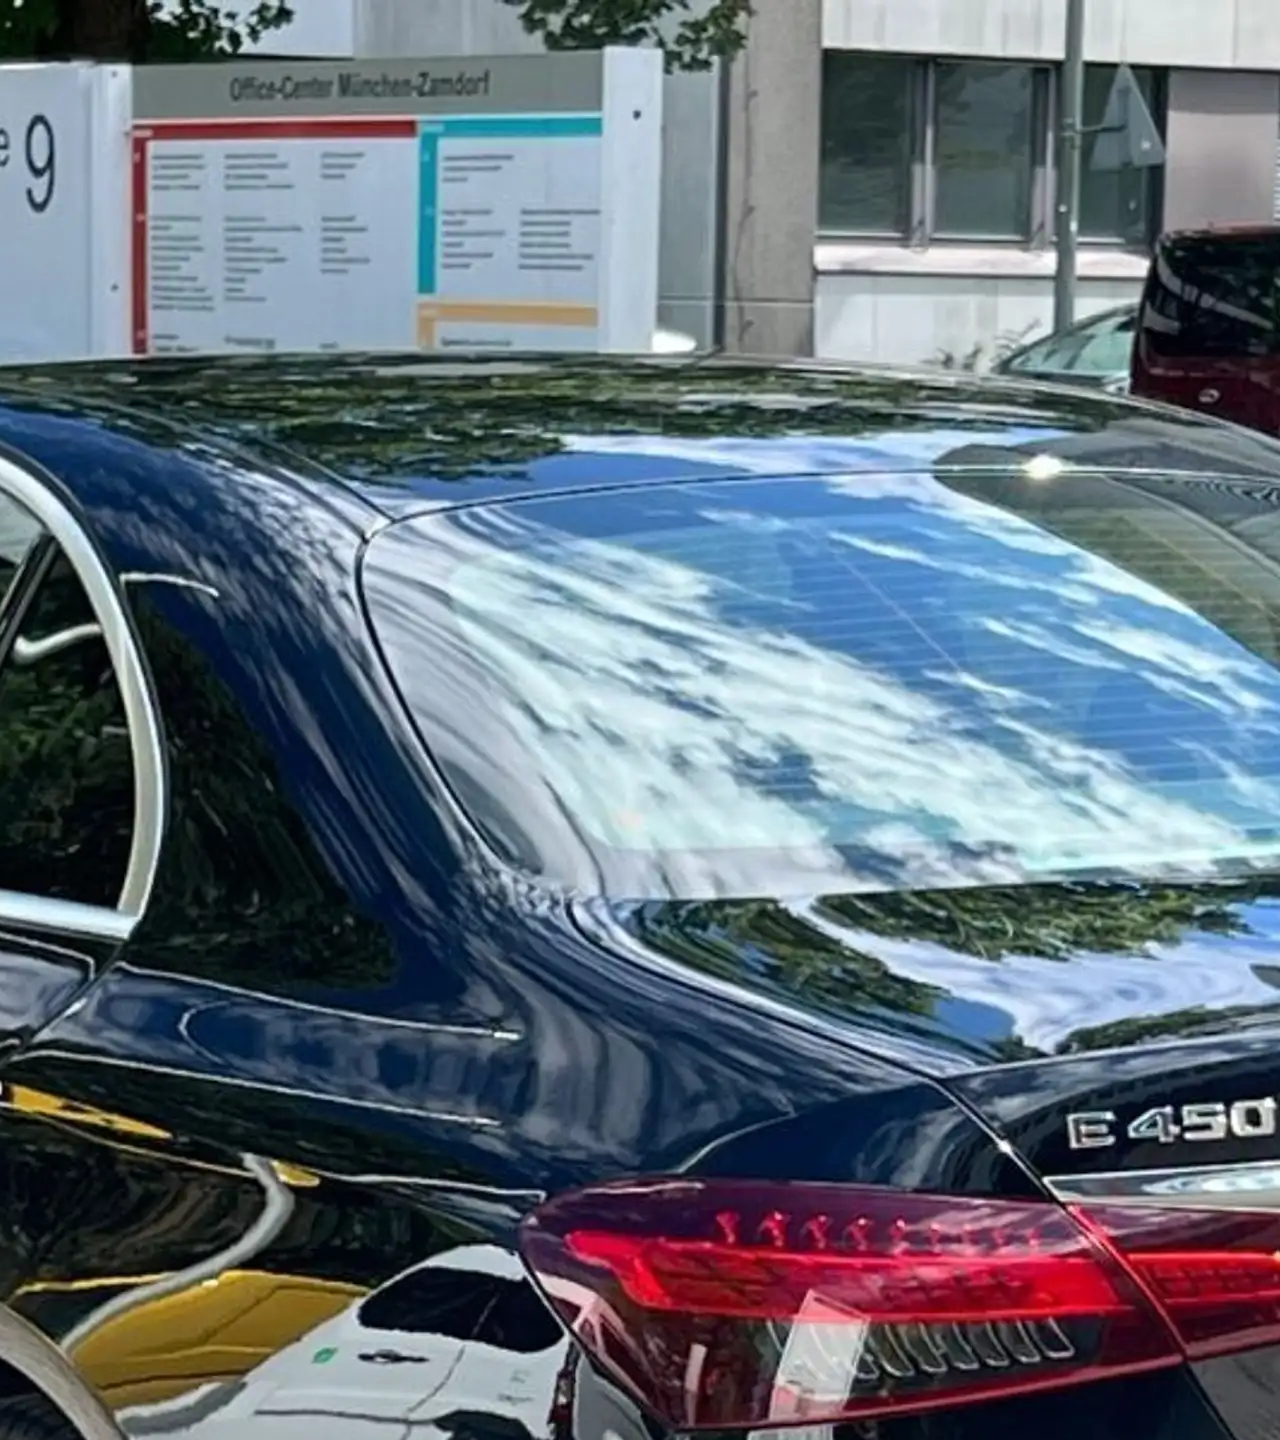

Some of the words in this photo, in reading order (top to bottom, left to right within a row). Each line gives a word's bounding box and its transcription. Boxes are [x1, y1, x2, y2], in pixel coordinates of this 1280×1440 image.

[229, 75, 333, 101] Office-Center
[24, 113, 56, 213] 9
[1067, 1110, 1116, 1149] E
[1127, 1096, 1277, 1143] 450
